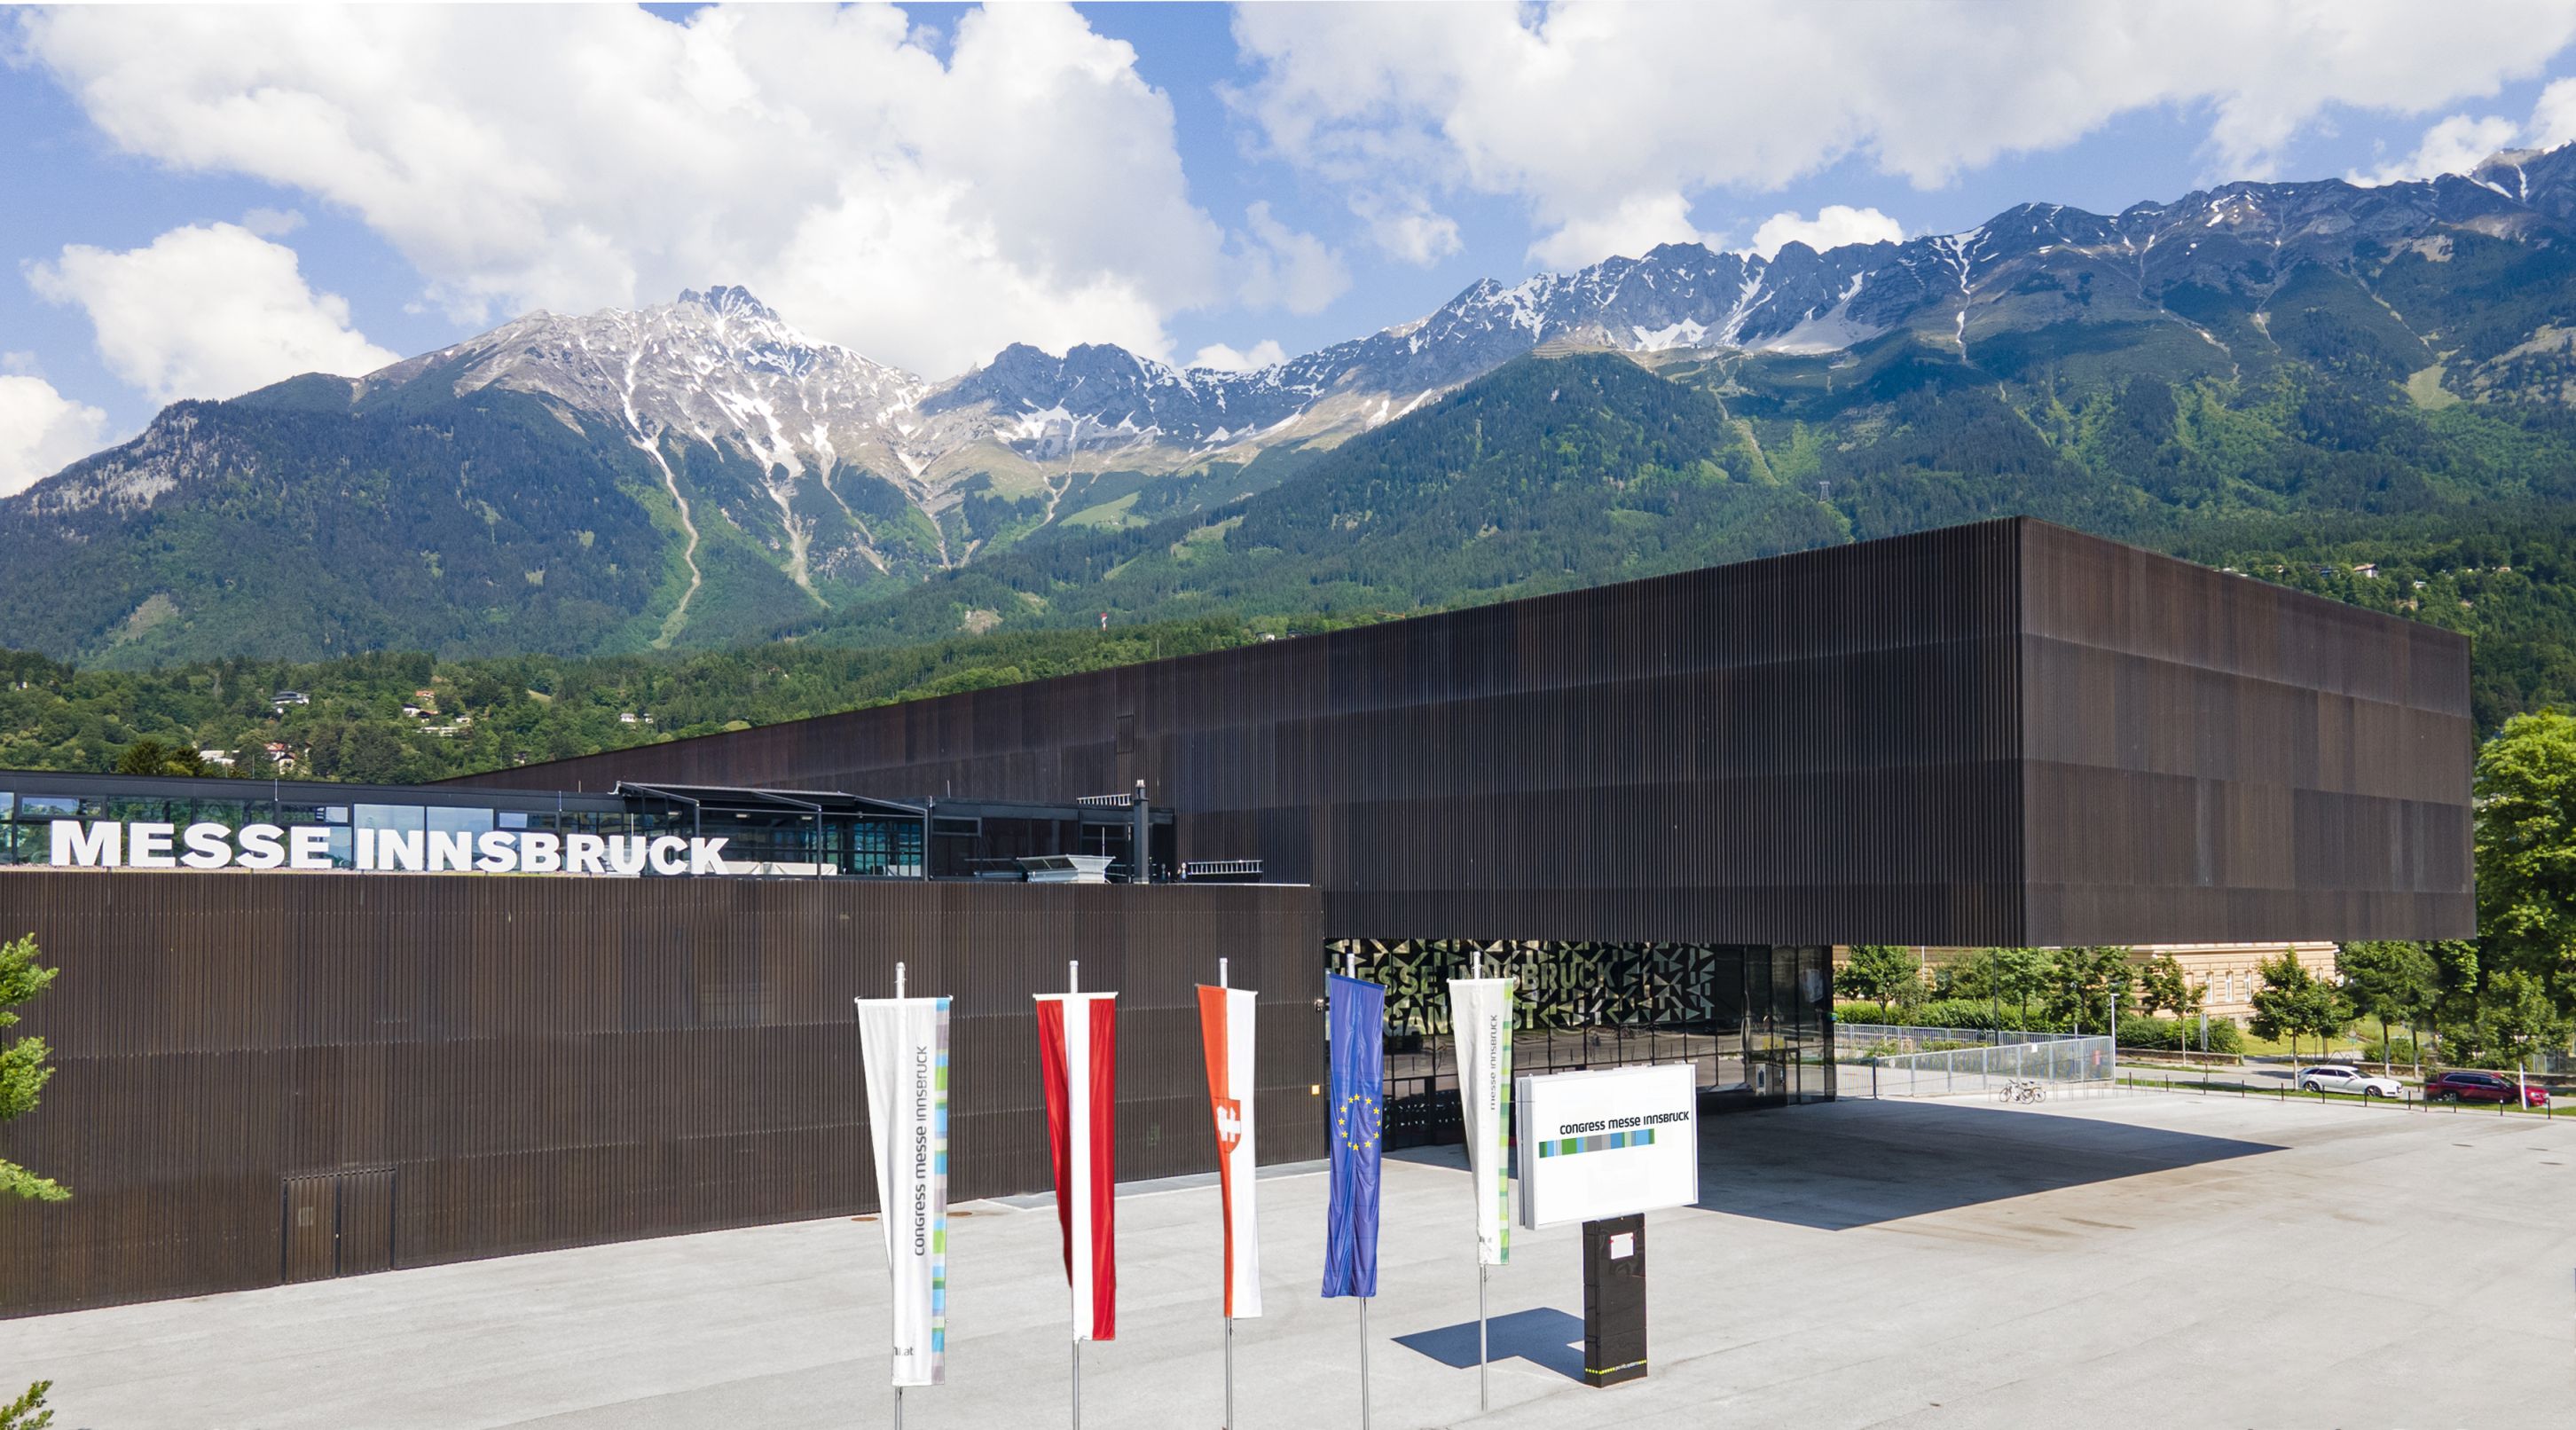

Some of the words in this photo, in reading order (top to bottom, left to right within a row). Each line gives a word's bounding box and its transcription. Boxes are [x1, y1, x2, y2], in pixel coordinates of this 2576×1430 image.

[51, 820, 332, 869] MESSE
[357, 827, 730, 876] INNSBRUCK
[1326, 965, 1438, 998] ESSE
[1608, 1115, 1641, 1130] messe
[915, 1126, 928, 1180] messe
